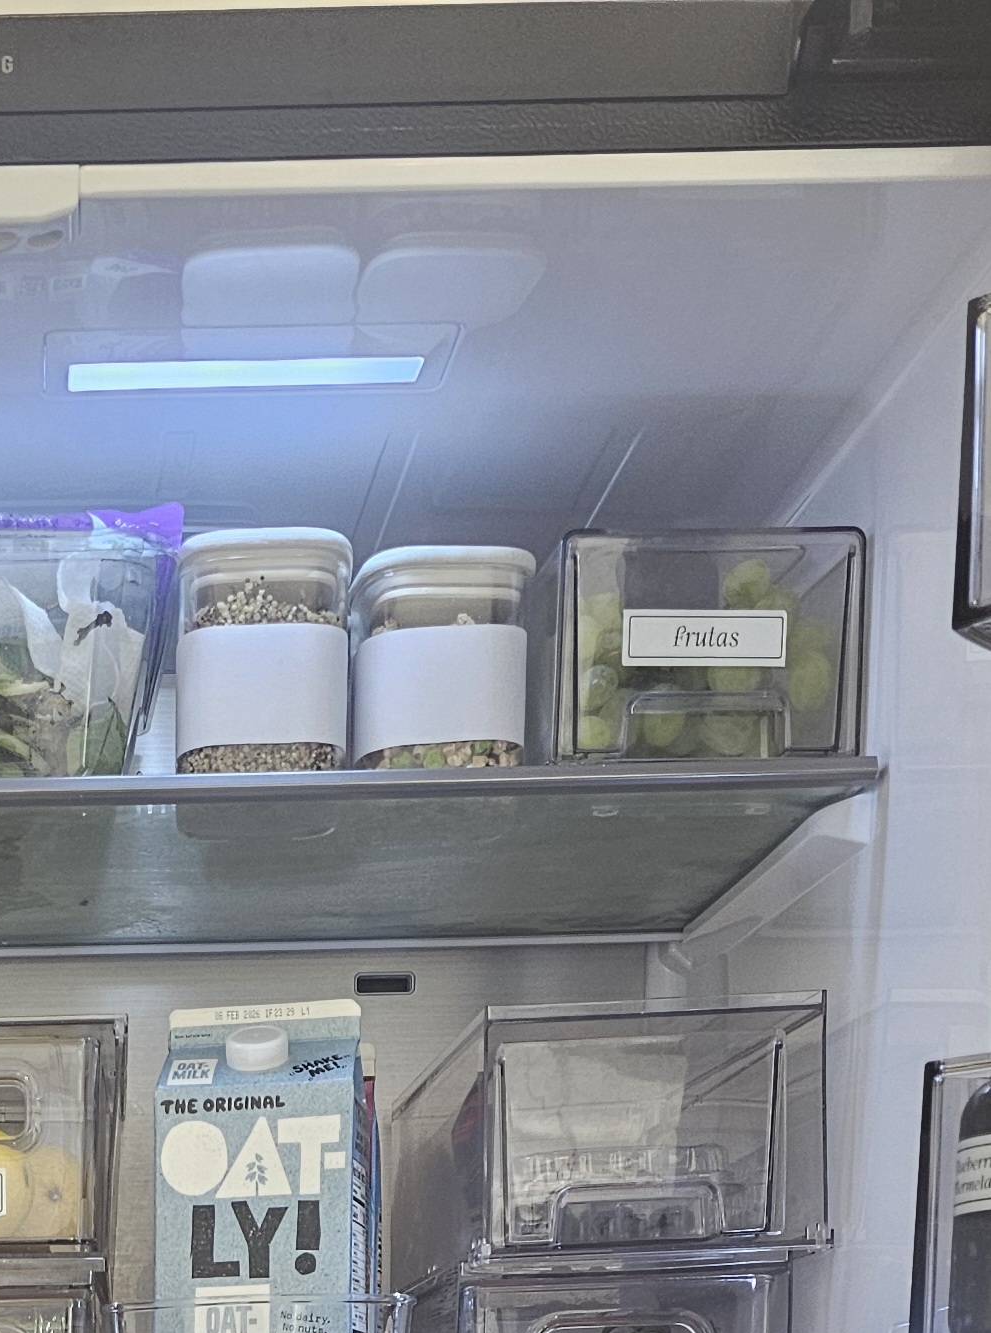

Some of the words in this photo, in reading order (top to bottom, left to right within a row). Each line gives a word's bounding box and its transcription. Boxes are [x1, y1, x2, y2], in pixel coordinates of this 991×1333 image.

[672, 625, 740, 648] Frutas
[226, 1010, 240, 1021] FEB
[171, 1069, 211, 1080] MILK
[176, 1061, 210, 1072] OAT-
[160, 1098, 198, 1115] THE
[202, 1095, 286, 1114] ORIGINAL
[160, 1113, 346, 1199] OAT-
[190, 1200, 321, 1279] LY!
